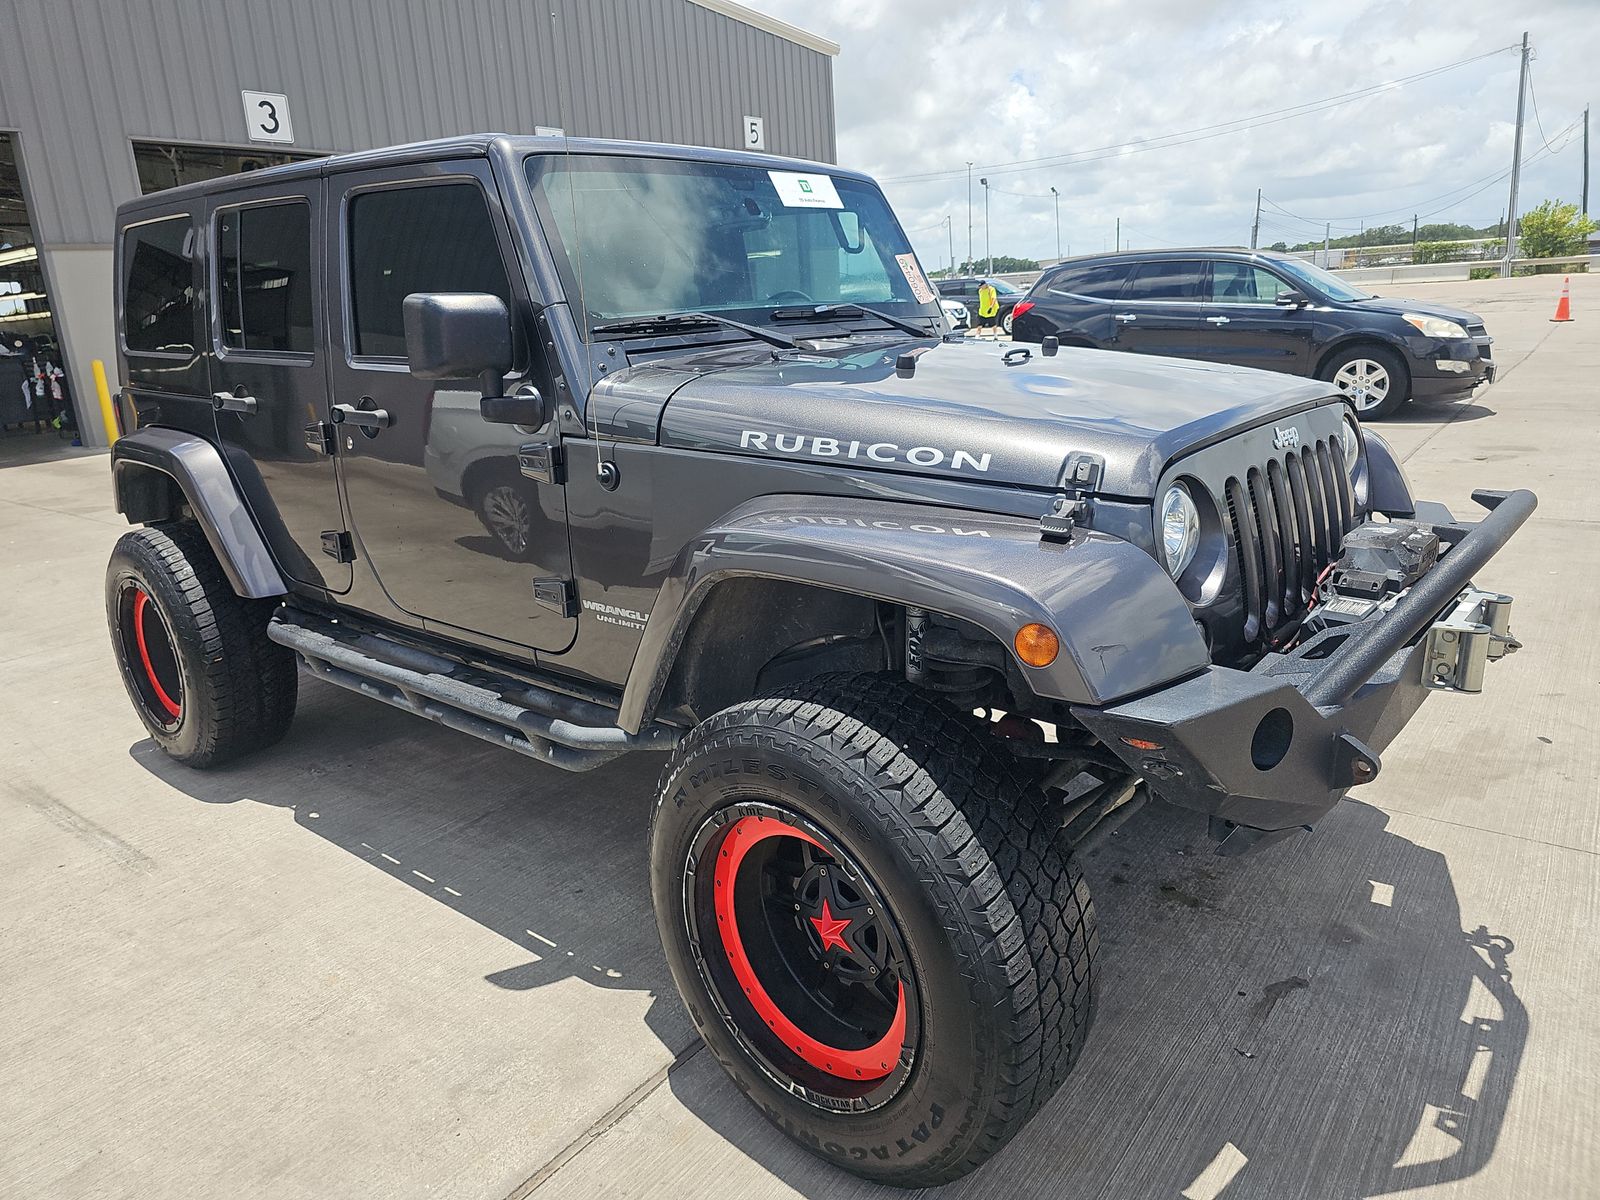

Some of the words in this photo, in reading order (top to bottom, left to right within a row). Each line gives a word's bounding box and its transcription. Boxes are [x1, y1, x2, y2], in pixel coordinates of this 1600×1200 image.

[258, 100, 280, 134] 3
[750, 122, 759, 144] 5
[740, 430, 992, 472] RUBICON
[1273, 426, 1299, 450] Jeep
[907, 620, 923, 673] FOX
